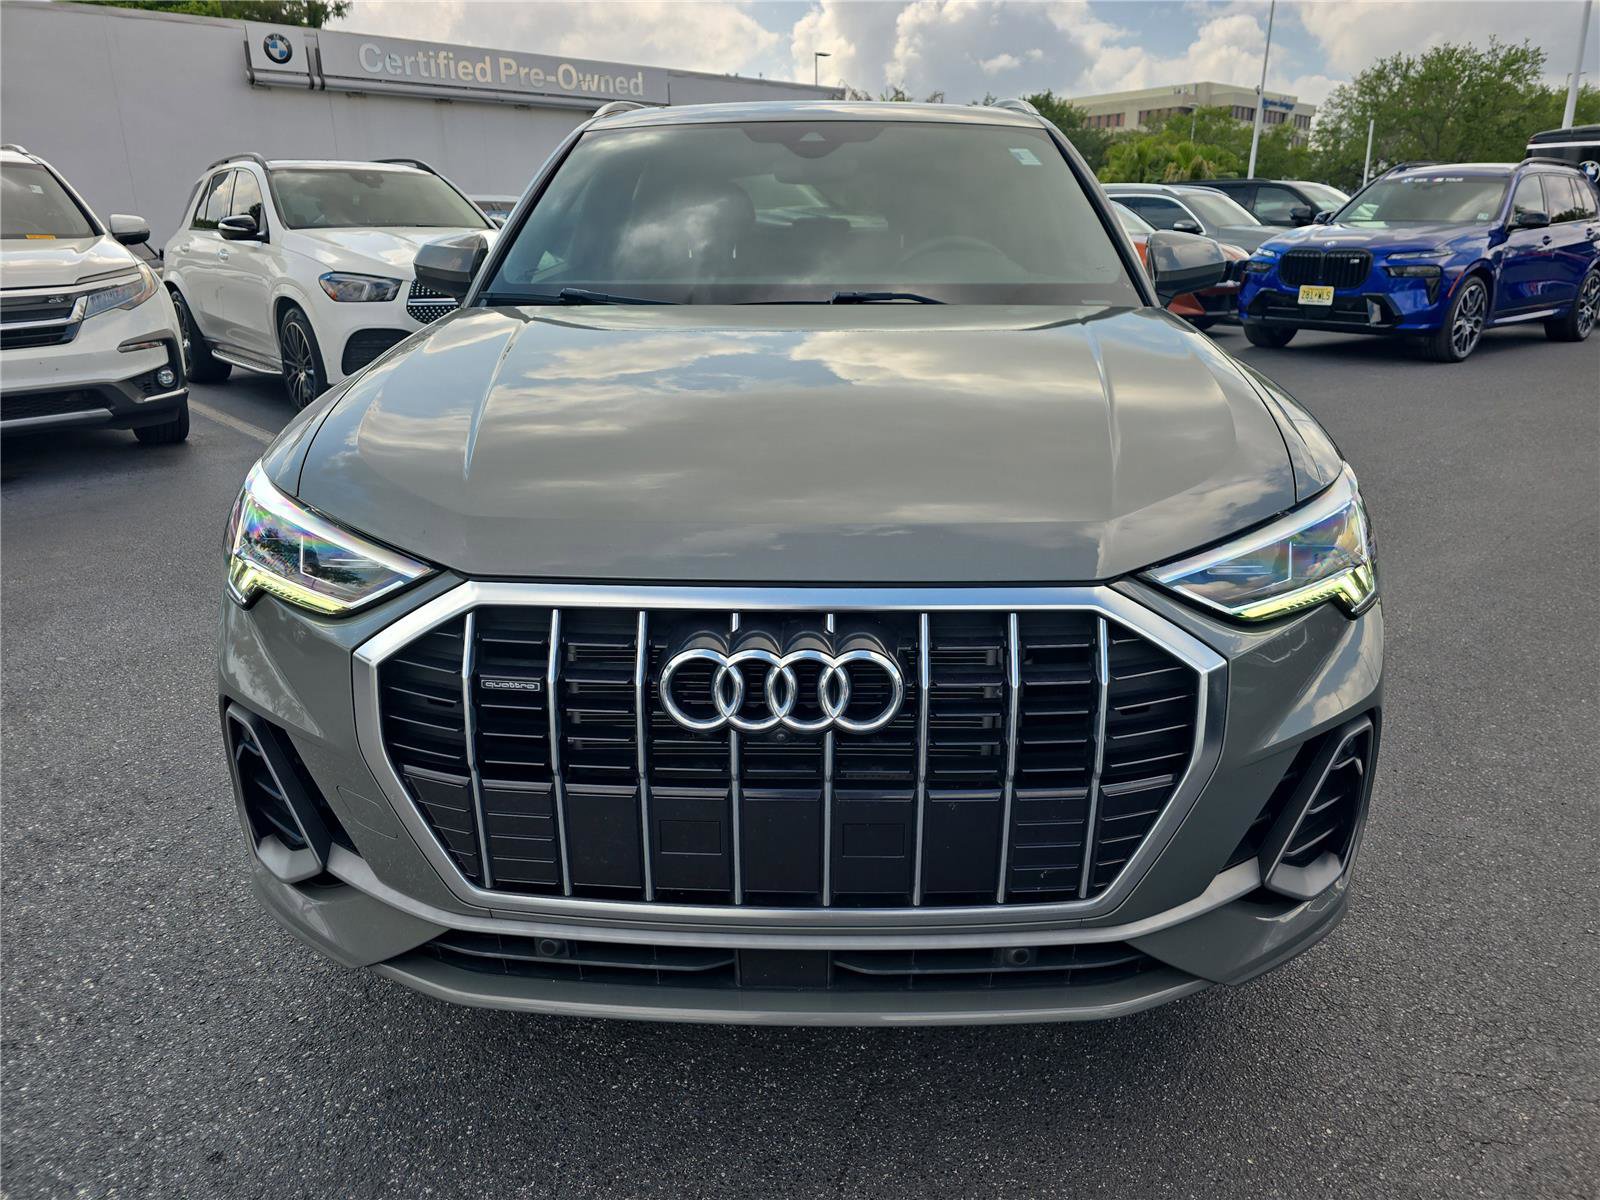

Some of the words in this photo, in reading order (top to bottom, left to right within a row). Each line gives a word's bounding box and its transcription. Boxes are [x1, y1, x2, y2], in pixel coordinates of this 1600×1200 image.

[358, 42, 493, 83] Certified
[499, 56, 644, 97] Pre-Owned
[485, 681, 535, 689] quattro
